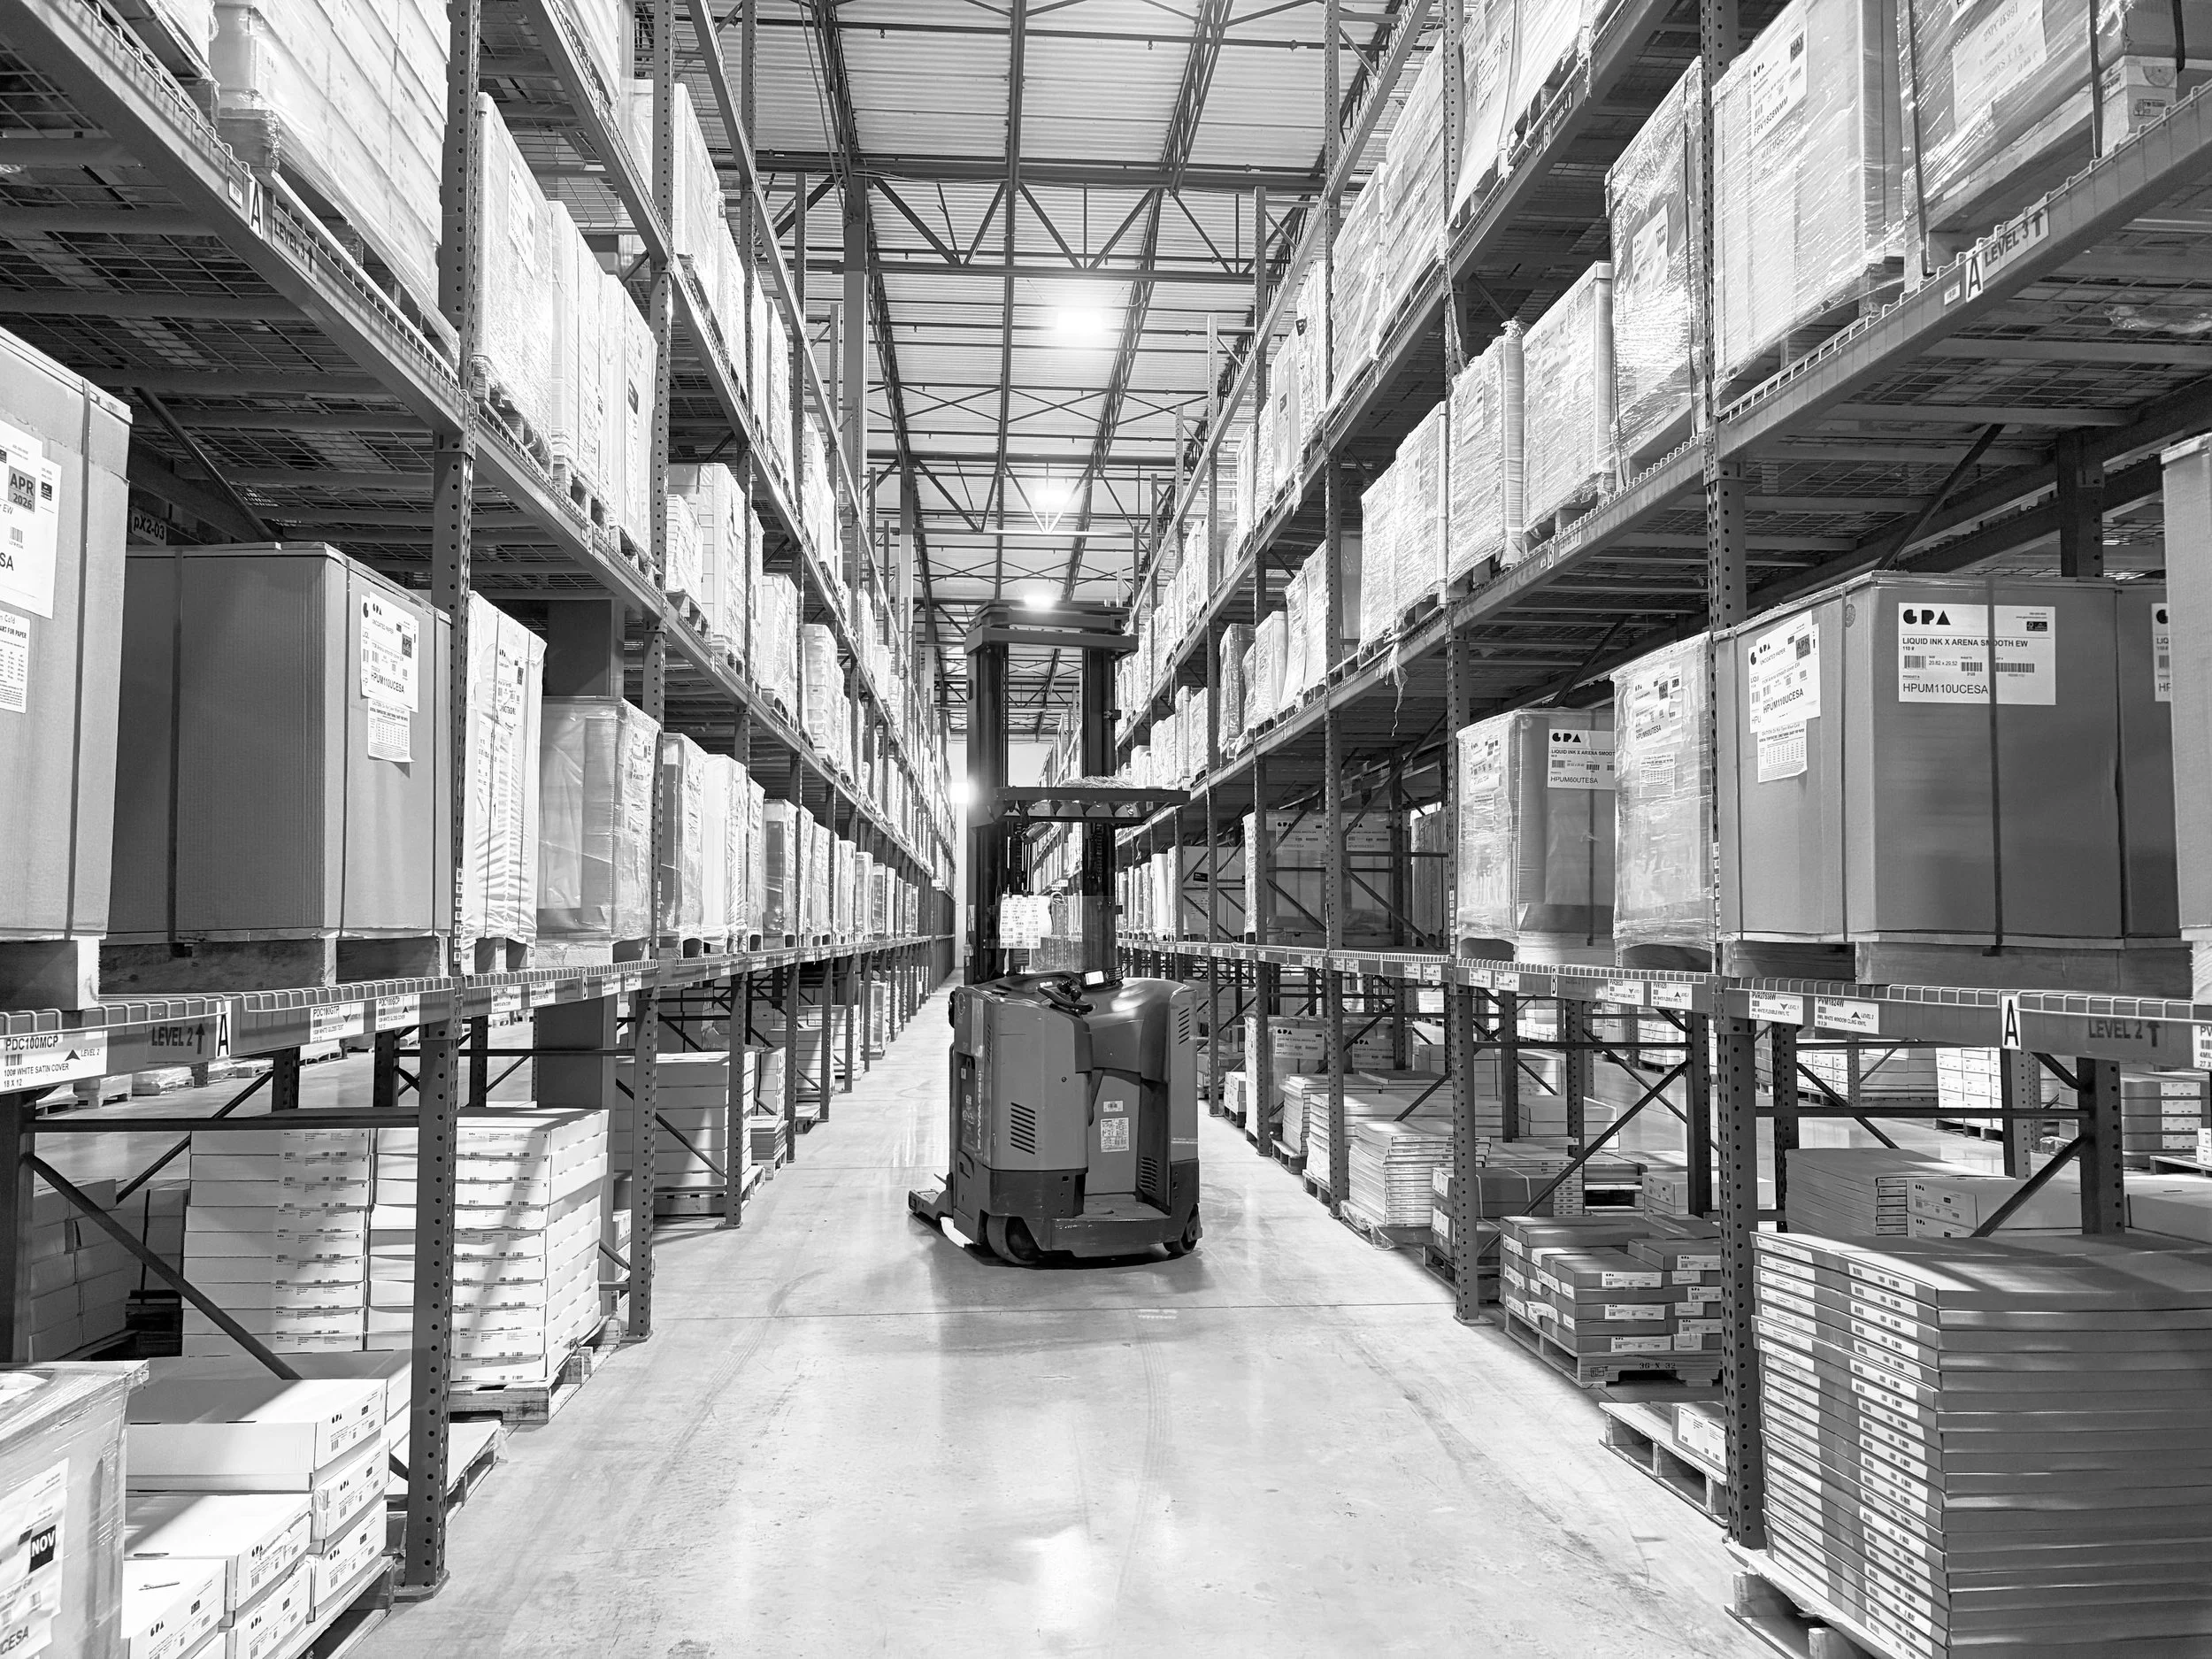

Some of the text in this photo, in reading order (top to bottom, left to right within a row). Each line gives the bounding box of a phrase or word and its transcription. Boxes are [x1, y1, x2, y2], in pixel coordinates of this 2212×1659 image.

[251, 182, 261, 234] A
[274, 218, 299, 255] LEVEL
[1985, 219, 2029, 267] LEVEL 3
[1967, 250, 1981, 298] A
[10, 472, 34, 496] APR
[13, 493, 32, 510] 2026
[134, 514, 165, 541] pX2-03
[1903, 609, 1951, 626] GPA
[1759, 643, 1770, 654] GPA
[1797, 637, 1810, 650] APR
[1903, 683, 1988, 694] HPUM110UCESA
[1763, 687, 1803, 714] HPUM110UCESA
[1552, 733, 1581, 743] GPA
[2004, 999, 2019, 1046] A
[2089, 1018, 2143, 1040] LEVEL 2
[5, 1035, 58, 1051] PDC100MCP
[151, 1025, 193, 1047] LEVEL 2
[218, 1014, 229, 1056] A
[81, 1048, 96, 1056] LEVEL
[17, 1066, 34, 1076] WHITE
[35, 1064, 50, 1073] SATIN
[51, 1063, 69, 1071] COVER
[31, 1531, 56, 1556] NOV
[0, 1625, 29, 1655] CESA
